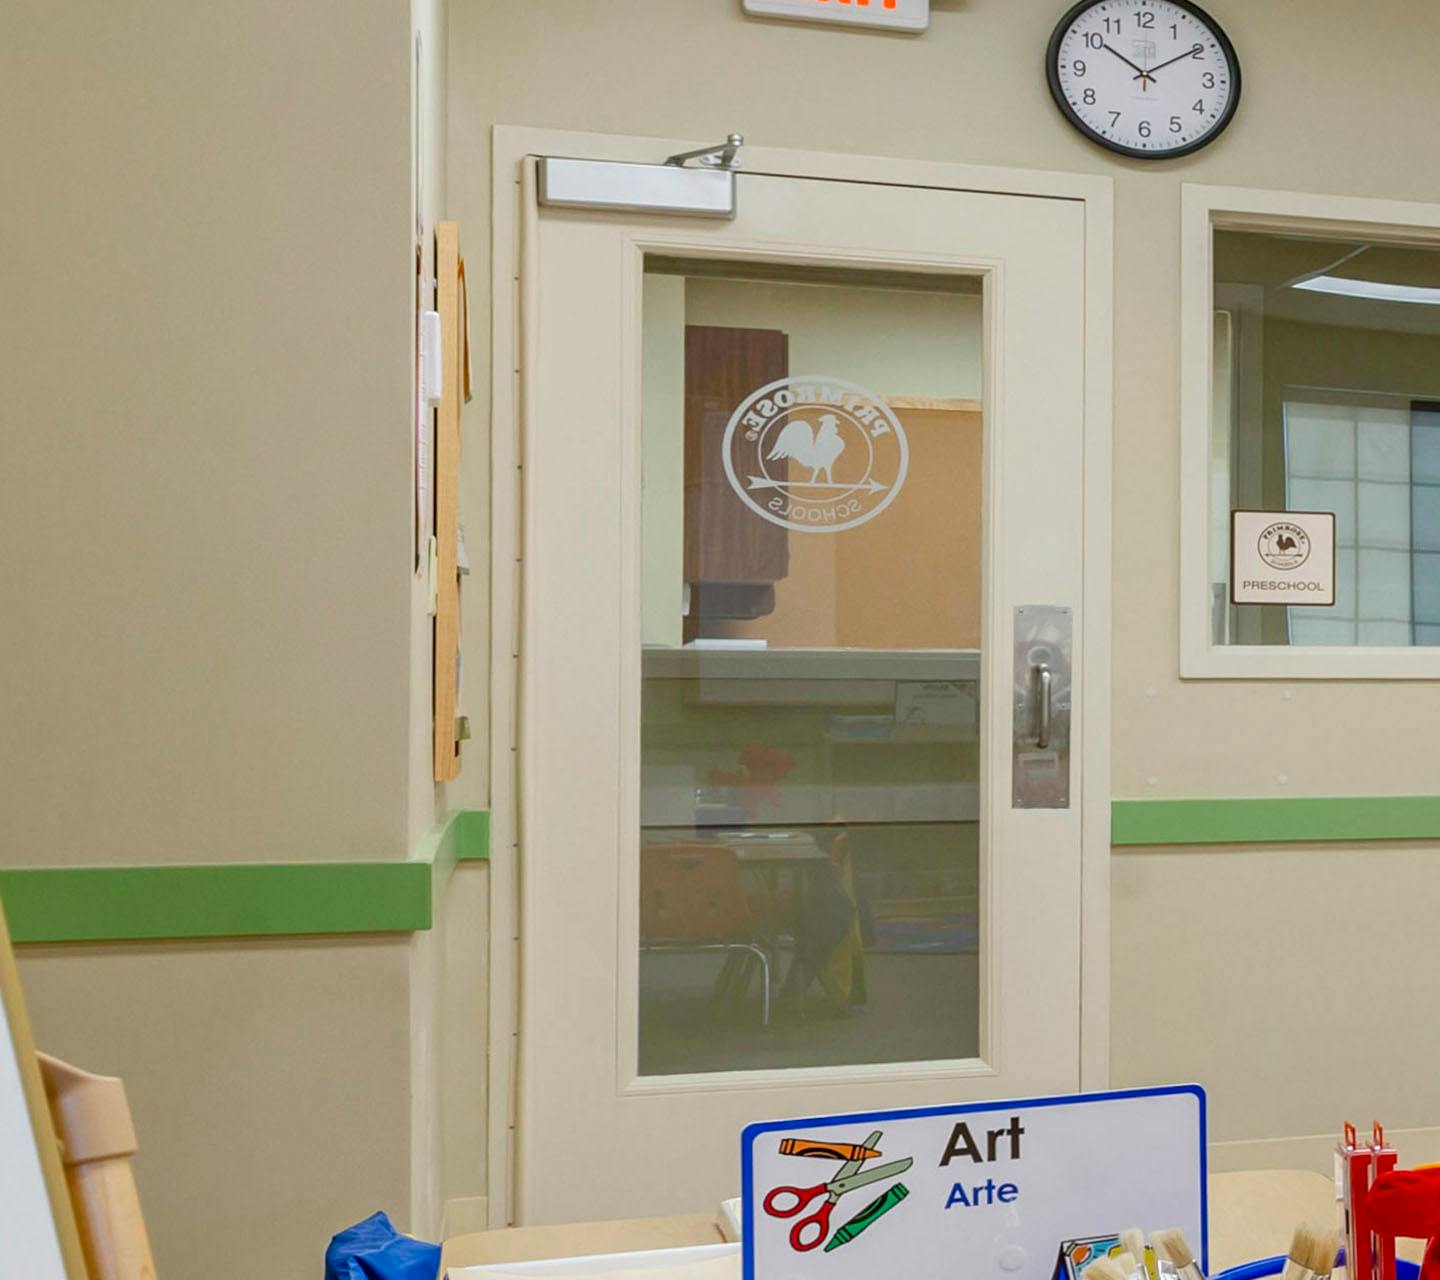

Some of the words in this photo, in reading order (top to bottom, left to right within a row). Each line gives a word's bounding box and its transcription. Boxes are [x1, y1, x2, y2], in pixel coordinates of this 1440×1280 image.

[1103, 17, 1121, 35] 11
[1134, 11, 1155, 29] 12
[1082, 32, 1104, 49] 10
[1169, 24, 1178, 40] 1
[1192, 43, 1205, 60] 2
[1073, 60, 1086, 77] 9
[1202, 72, 1215, 89] 3
[1083, 88, 1096, 105] 8
[1192, 99, 1204, 115] 4
[1108, 111, 1121, 128] 7
[1169, 116, 1182, 133] 5
[1138, 121, 1151, 138] 6
[1242, 580, 1325, 592] PRESCHOOL
[939, 1116, 1025, 1168] Art
[944, 1178, 1019, 1210] Arte
